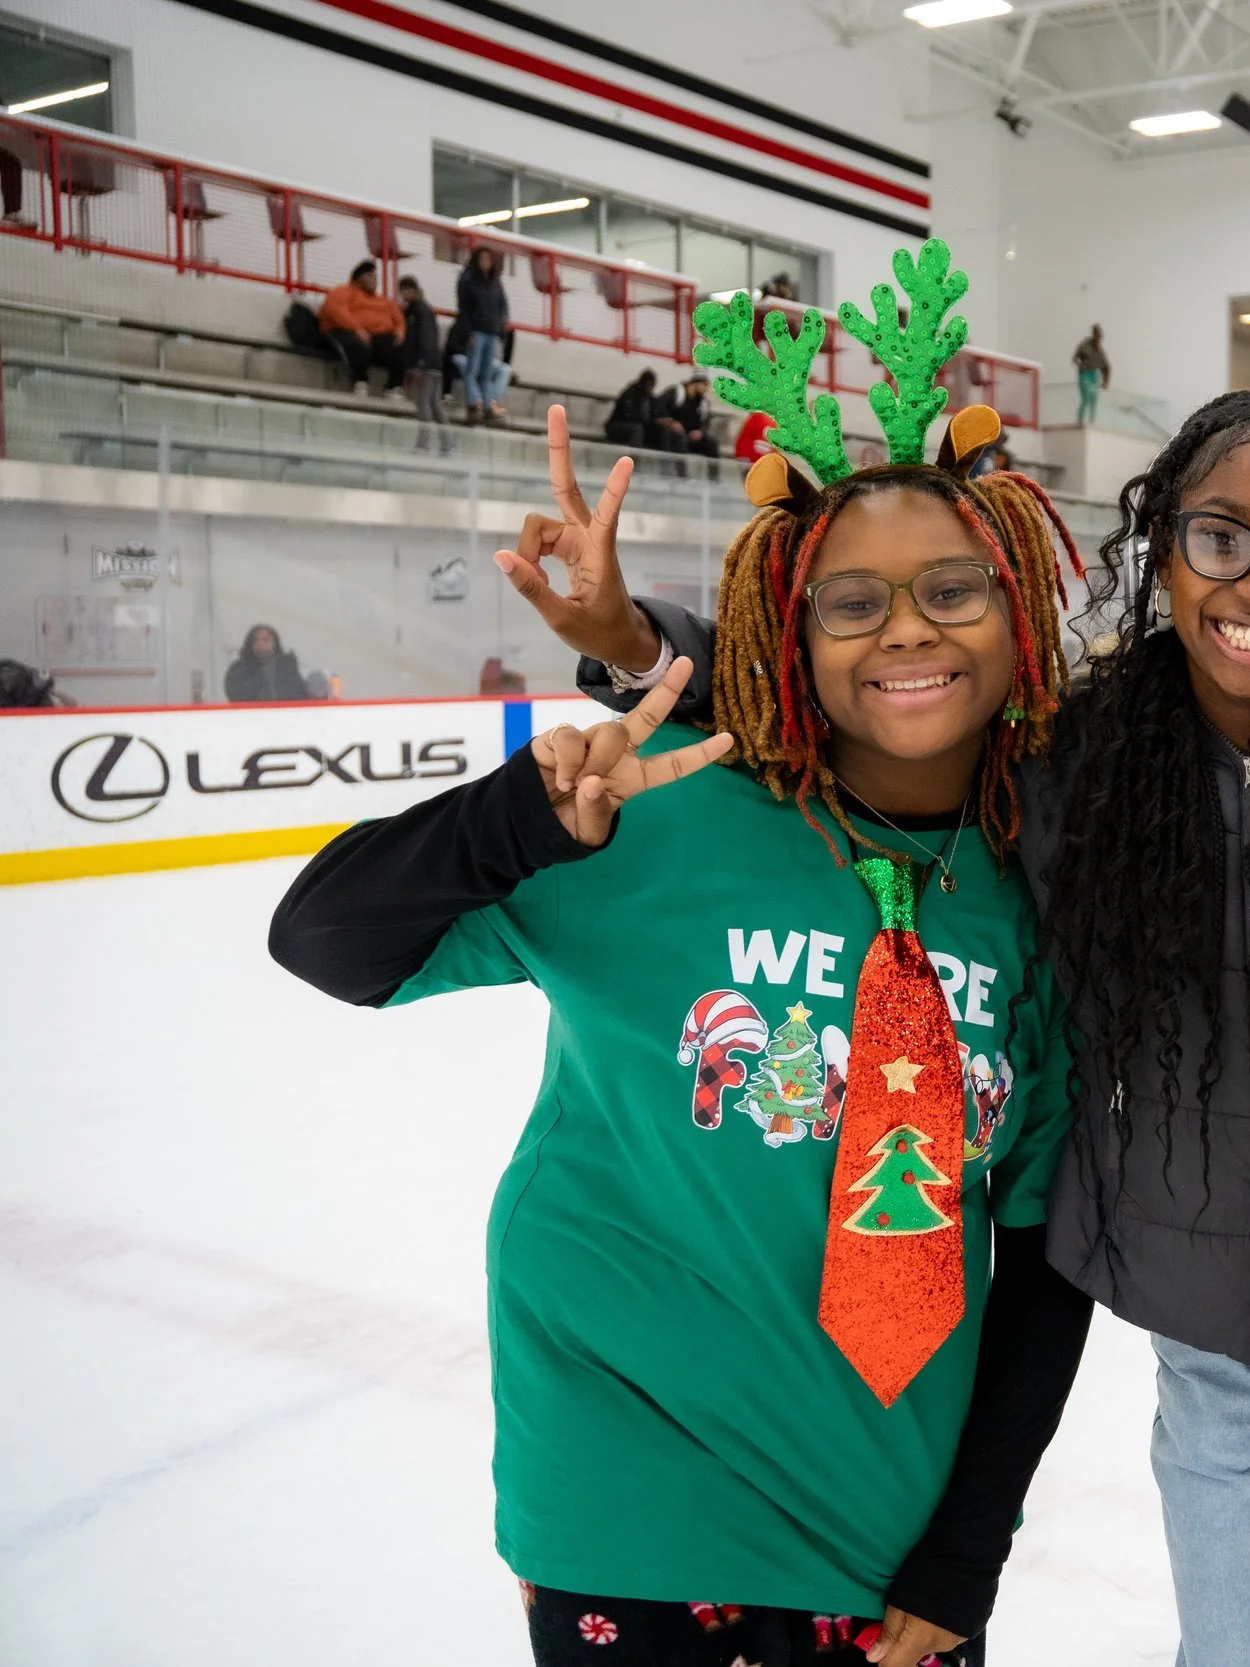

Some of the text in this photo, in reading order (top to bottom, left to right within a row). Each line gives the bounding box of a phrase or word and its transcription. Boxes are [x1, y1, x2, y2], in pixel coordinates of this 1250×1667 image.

[186, 738, 468, 793] LEXUS
[727, 928, 998, 1027] WE RE
